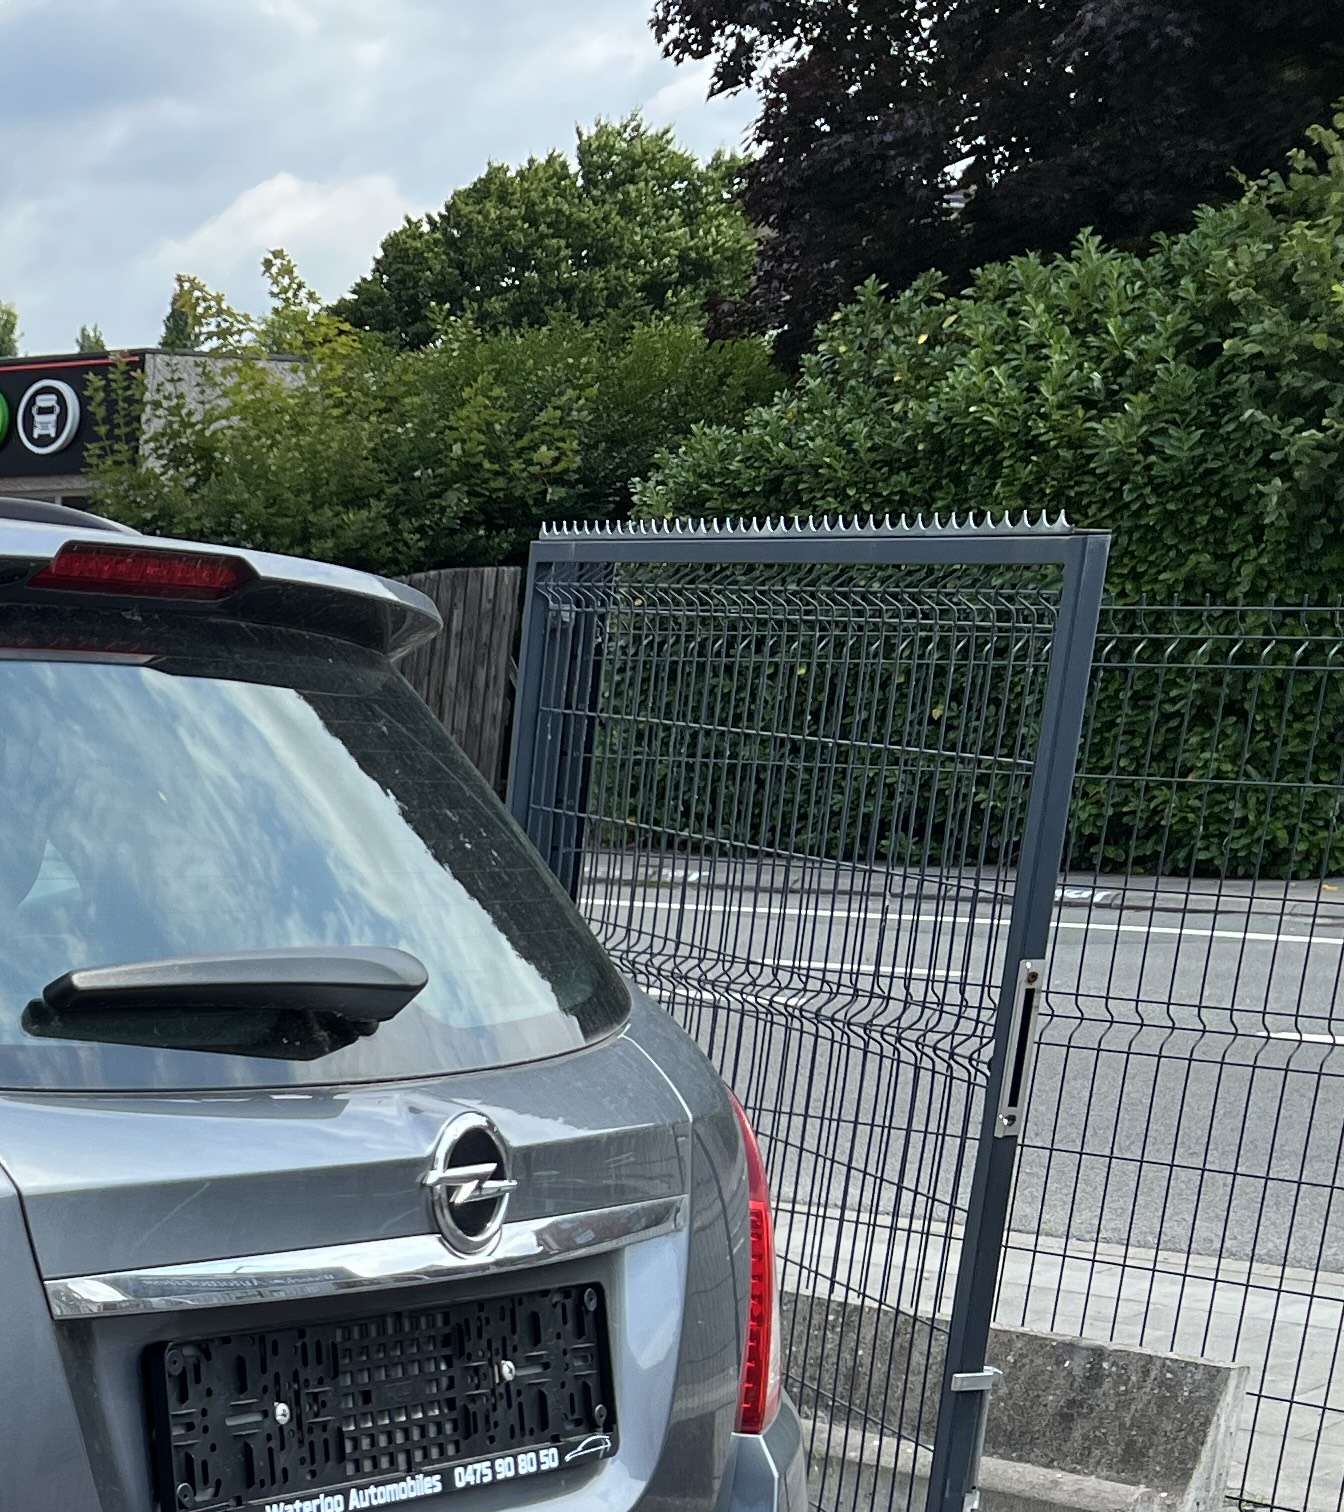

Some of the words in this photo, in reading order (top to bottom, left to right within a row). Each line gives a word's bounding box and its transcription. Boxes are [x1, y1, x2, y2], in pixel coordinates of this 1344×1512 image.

[348, 1473, 443, 1511] Automobiles
[454, 1460, 493, 1488] 0475
[494, 1457, 516, 1481] 90
[517, 1452, 538, 1476] 80
[539, 1447, 560, 1470] 50
